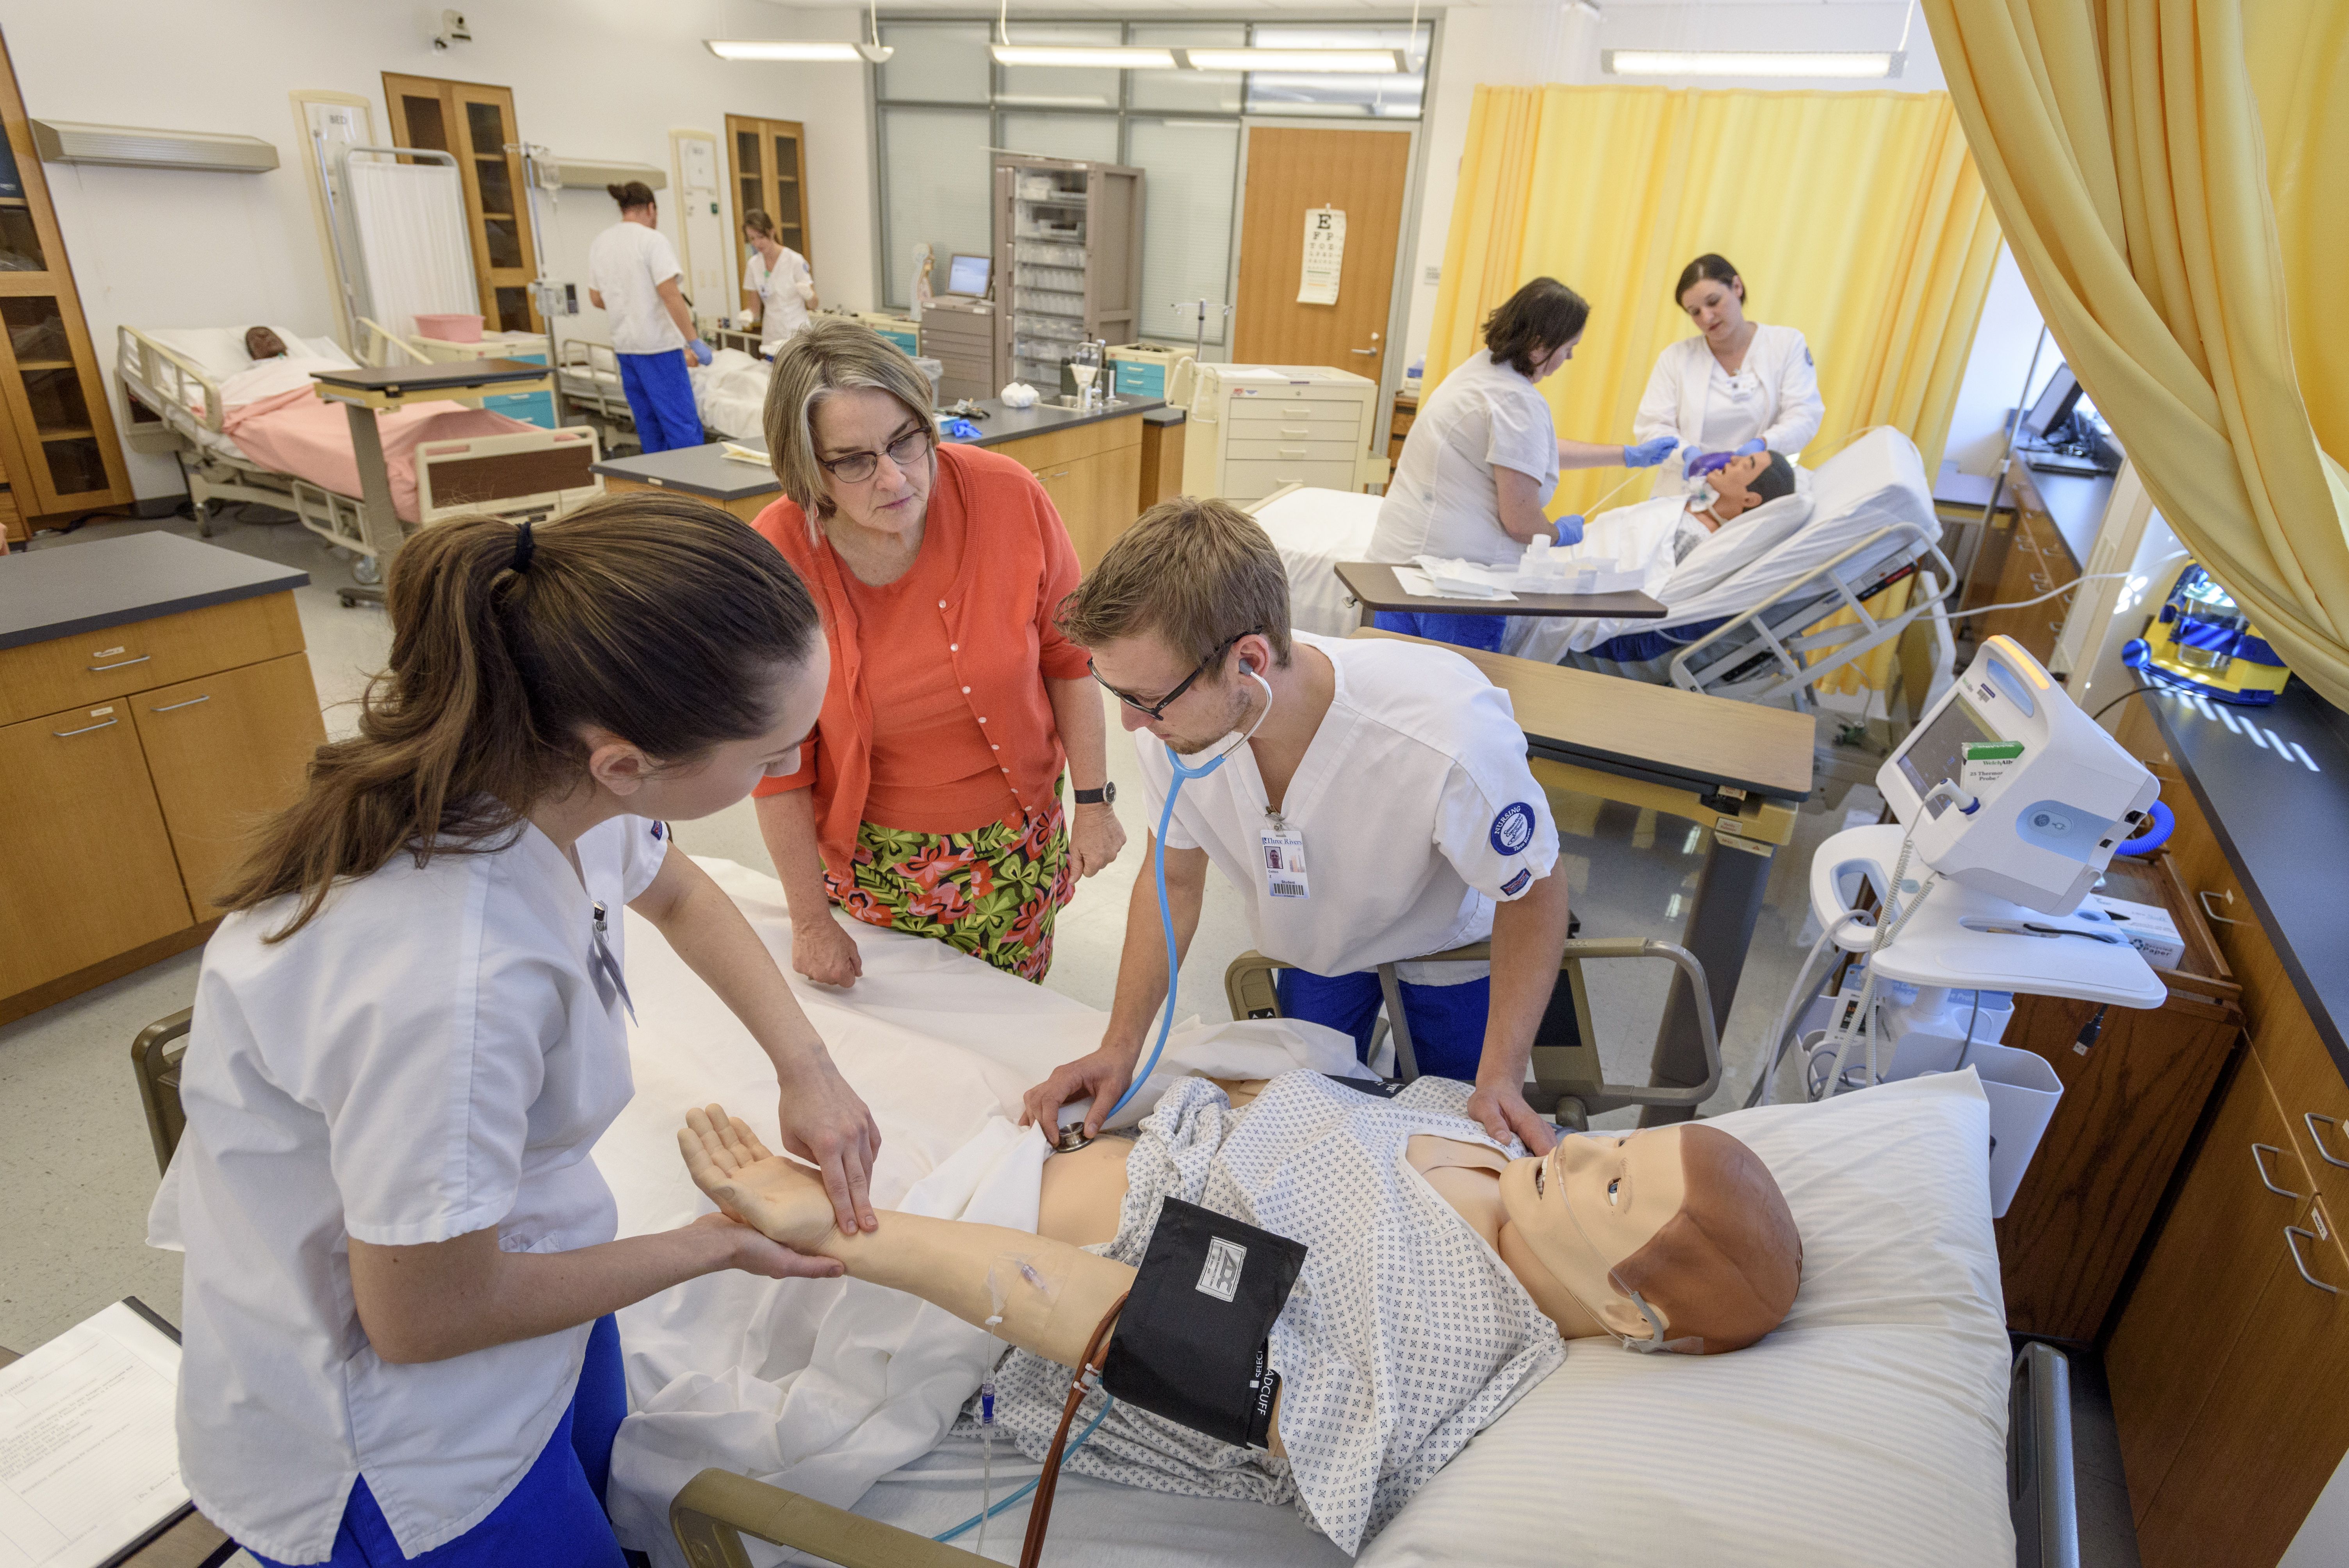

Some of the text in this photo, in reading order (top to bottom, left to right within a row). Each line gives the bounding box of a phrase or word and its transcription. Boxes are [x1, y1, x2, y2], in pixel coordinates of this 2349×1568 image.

[330, 115, 347, 124] BED
[1317, 213, 1331, 230] E
[1327, 232, 1334, 241] P
[1494, 806, 1521, 834] NURSING
[1504, 813, 1521, 834] Connecticut
[1506, 816, 1523, 837] Community
[1512, 821, 1524, 836] Colleges
[1513, 828, 1532, 851] Three Rivers
[2143, 946, 2170, 956] Paper
[1257, 1367, 1275, 1416] ADCUFF
